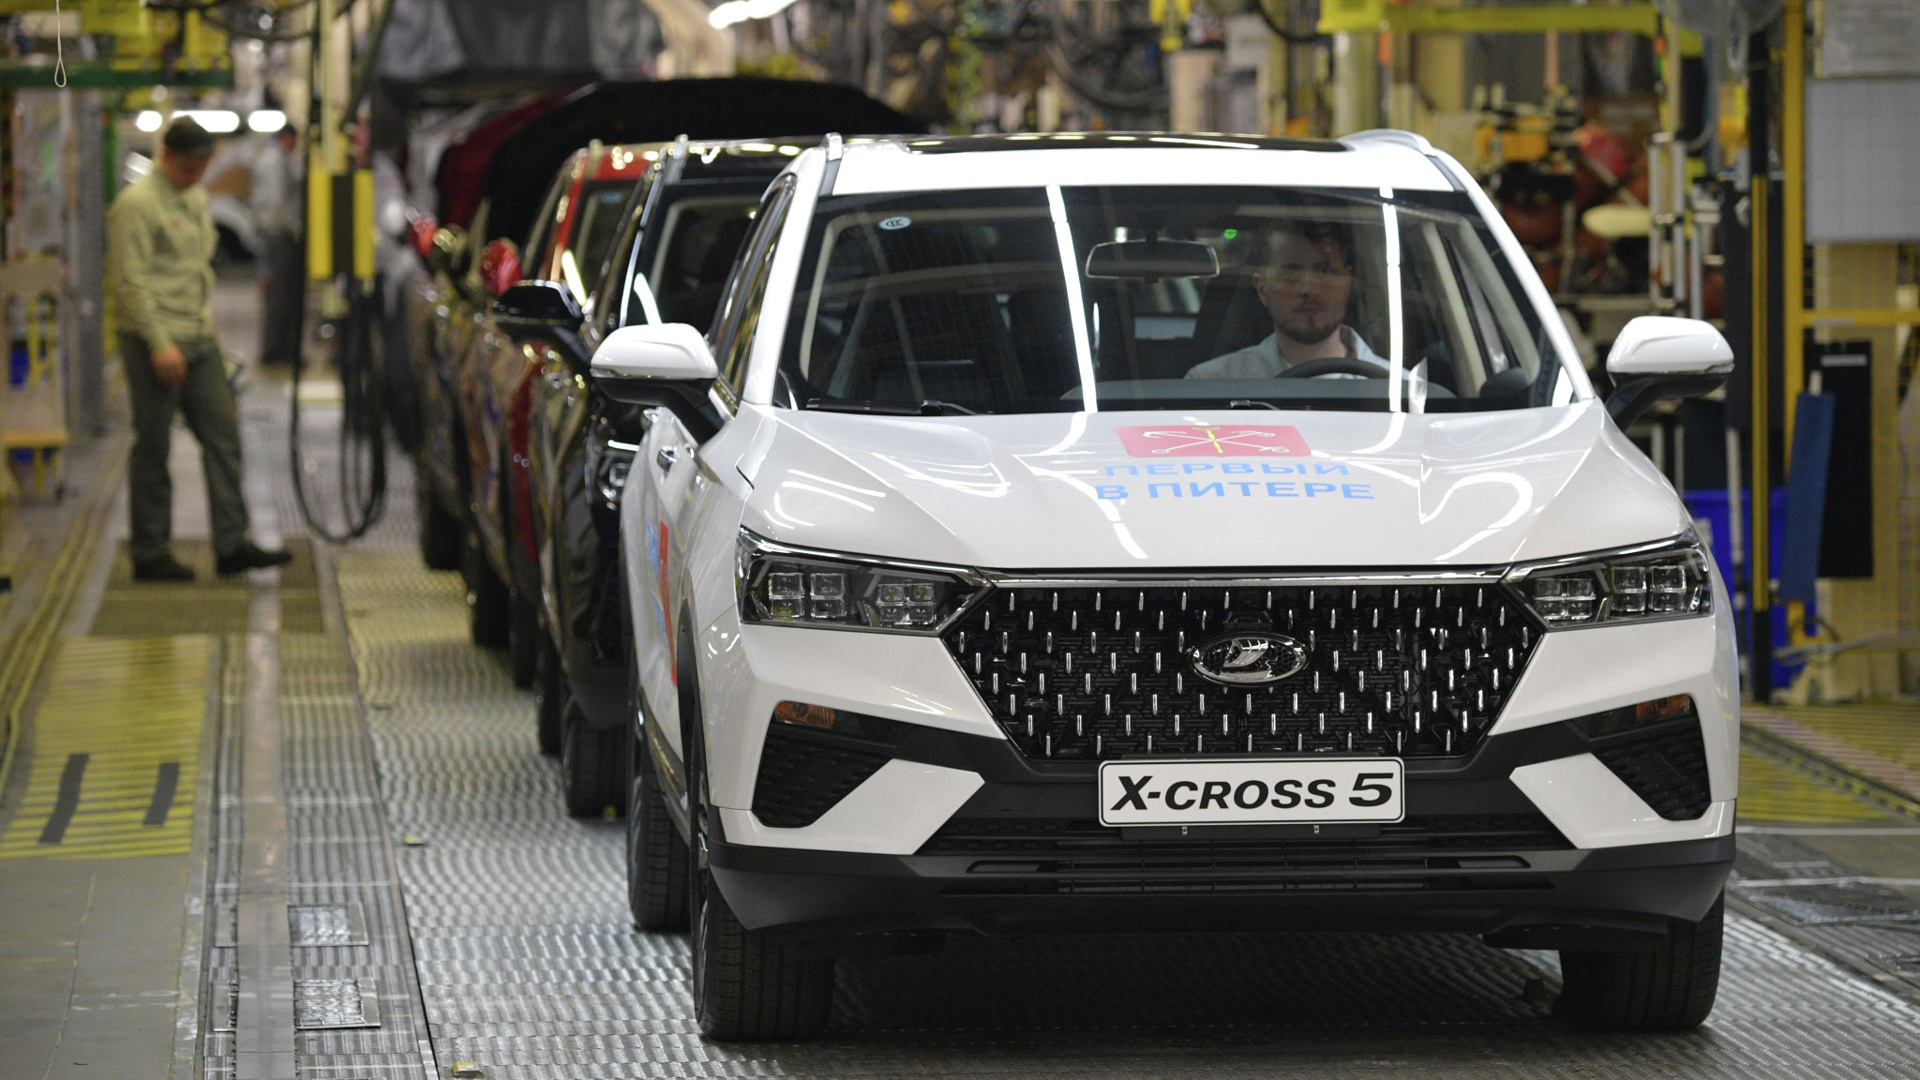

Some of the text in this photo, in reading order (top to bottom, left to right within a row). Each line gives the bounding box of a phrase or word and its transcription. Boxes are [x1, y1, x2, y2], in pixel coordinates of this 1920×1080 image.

[1105, 463, 1350, 477] ПЕРВЫЙ
[1096, 482, 1375, 500] В ПИТЕРЕ
[1110, 773, 1394, 810] X-CROSS 5
